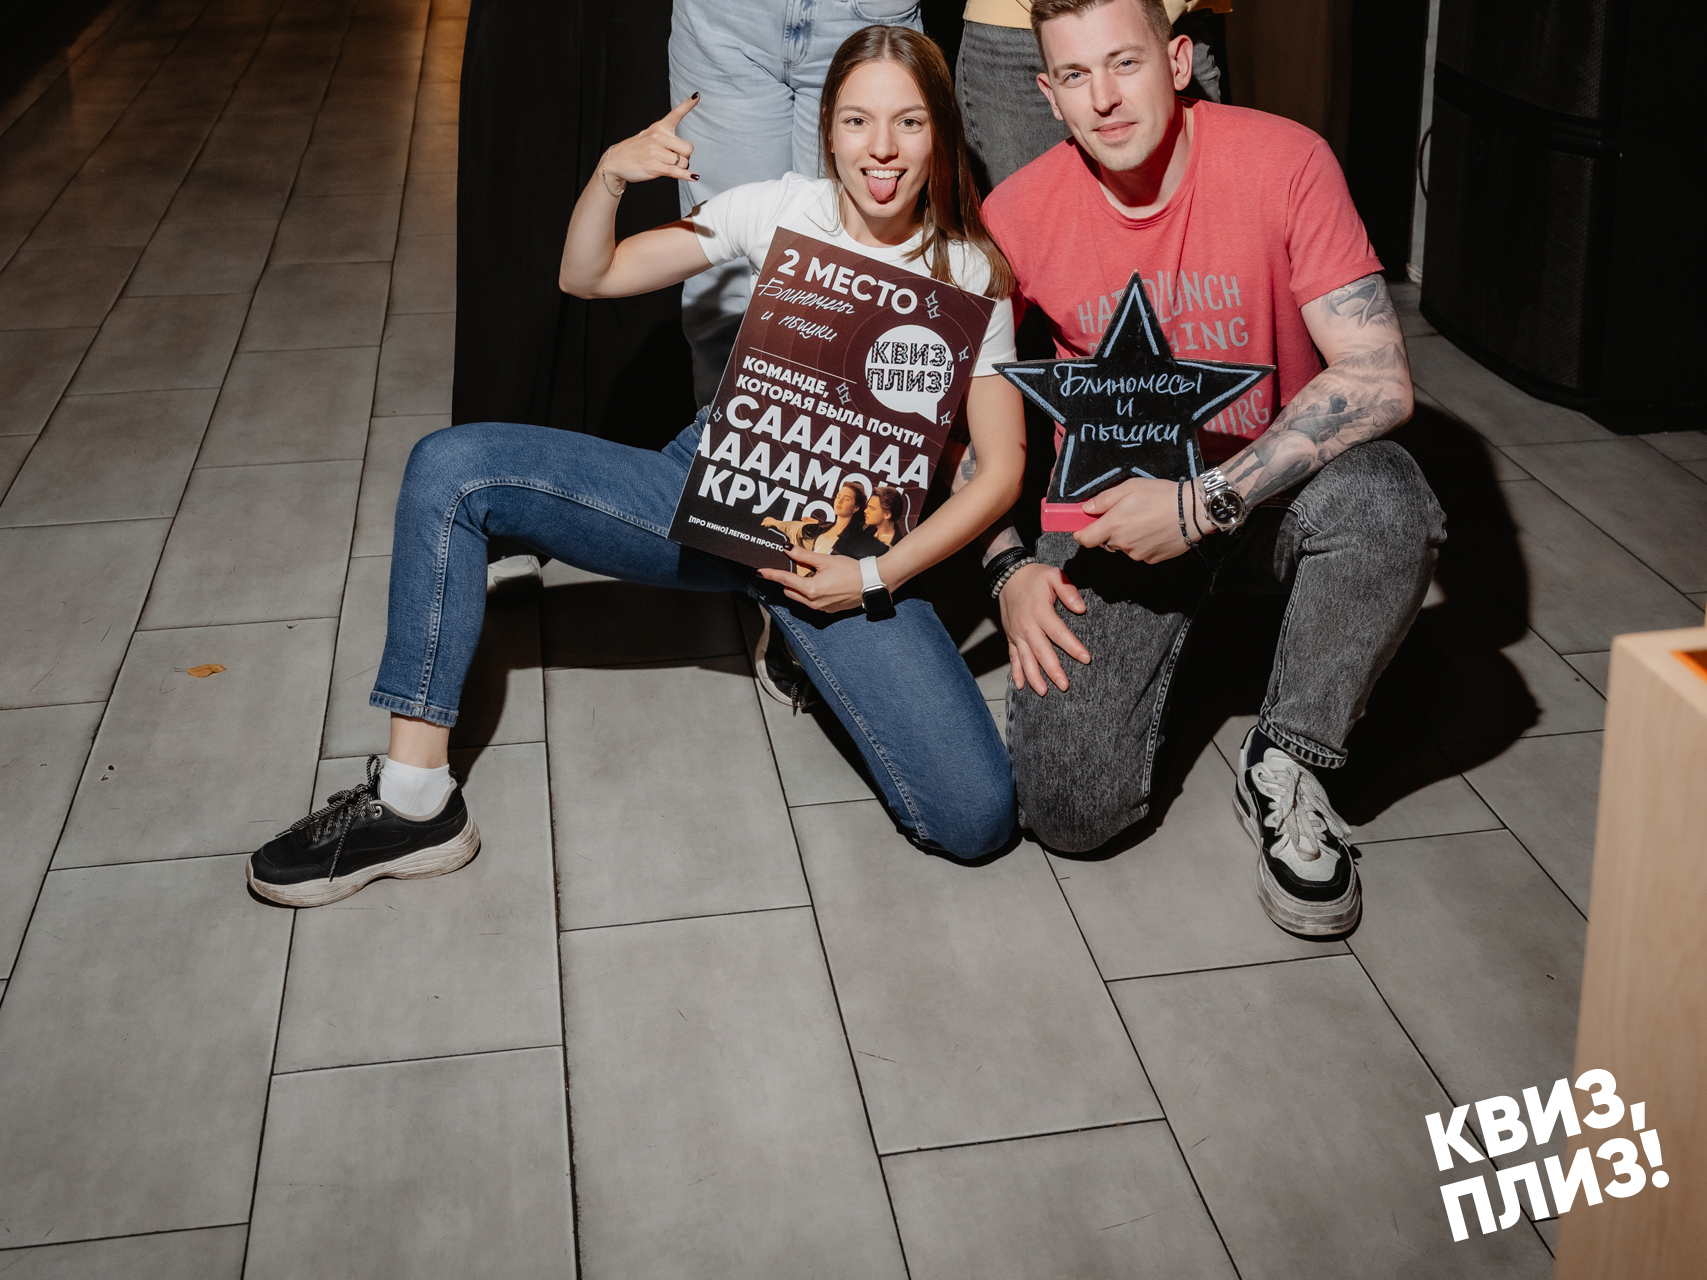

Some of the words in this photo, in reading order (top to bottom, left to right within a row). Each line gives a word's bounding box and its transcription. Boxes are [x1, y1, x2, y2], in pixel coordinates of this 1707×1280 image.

[776, 248, 801, 277] 2
[804, 256, 918, 315] МЕСТО
[870, 340, 954, 371] КВИЗ,
[742, 355, 830, 399] КОМАНДЕ,
[866, 367, 951, 394] ПЛИЗ!
[1053, 363, 1203, 397] Блиномесы
[736, 374, 816, 412] КОТОРАЯ
[815, 400, 864, 429] БЫЛА
[866, 417, 925, 448] ПОЧТИ
[726, 394, 929, 490] САААААА
[1080, 422, 1180, 448] пышки
[688, 515, 706, 527] [ПРО
[706, 521, 729, 535] КИНО]
[728, 528, 751, 541] ЛЕГКО
[750, 535, 756, 543] И
[756, 538, 784, 552] ПРОСТО
